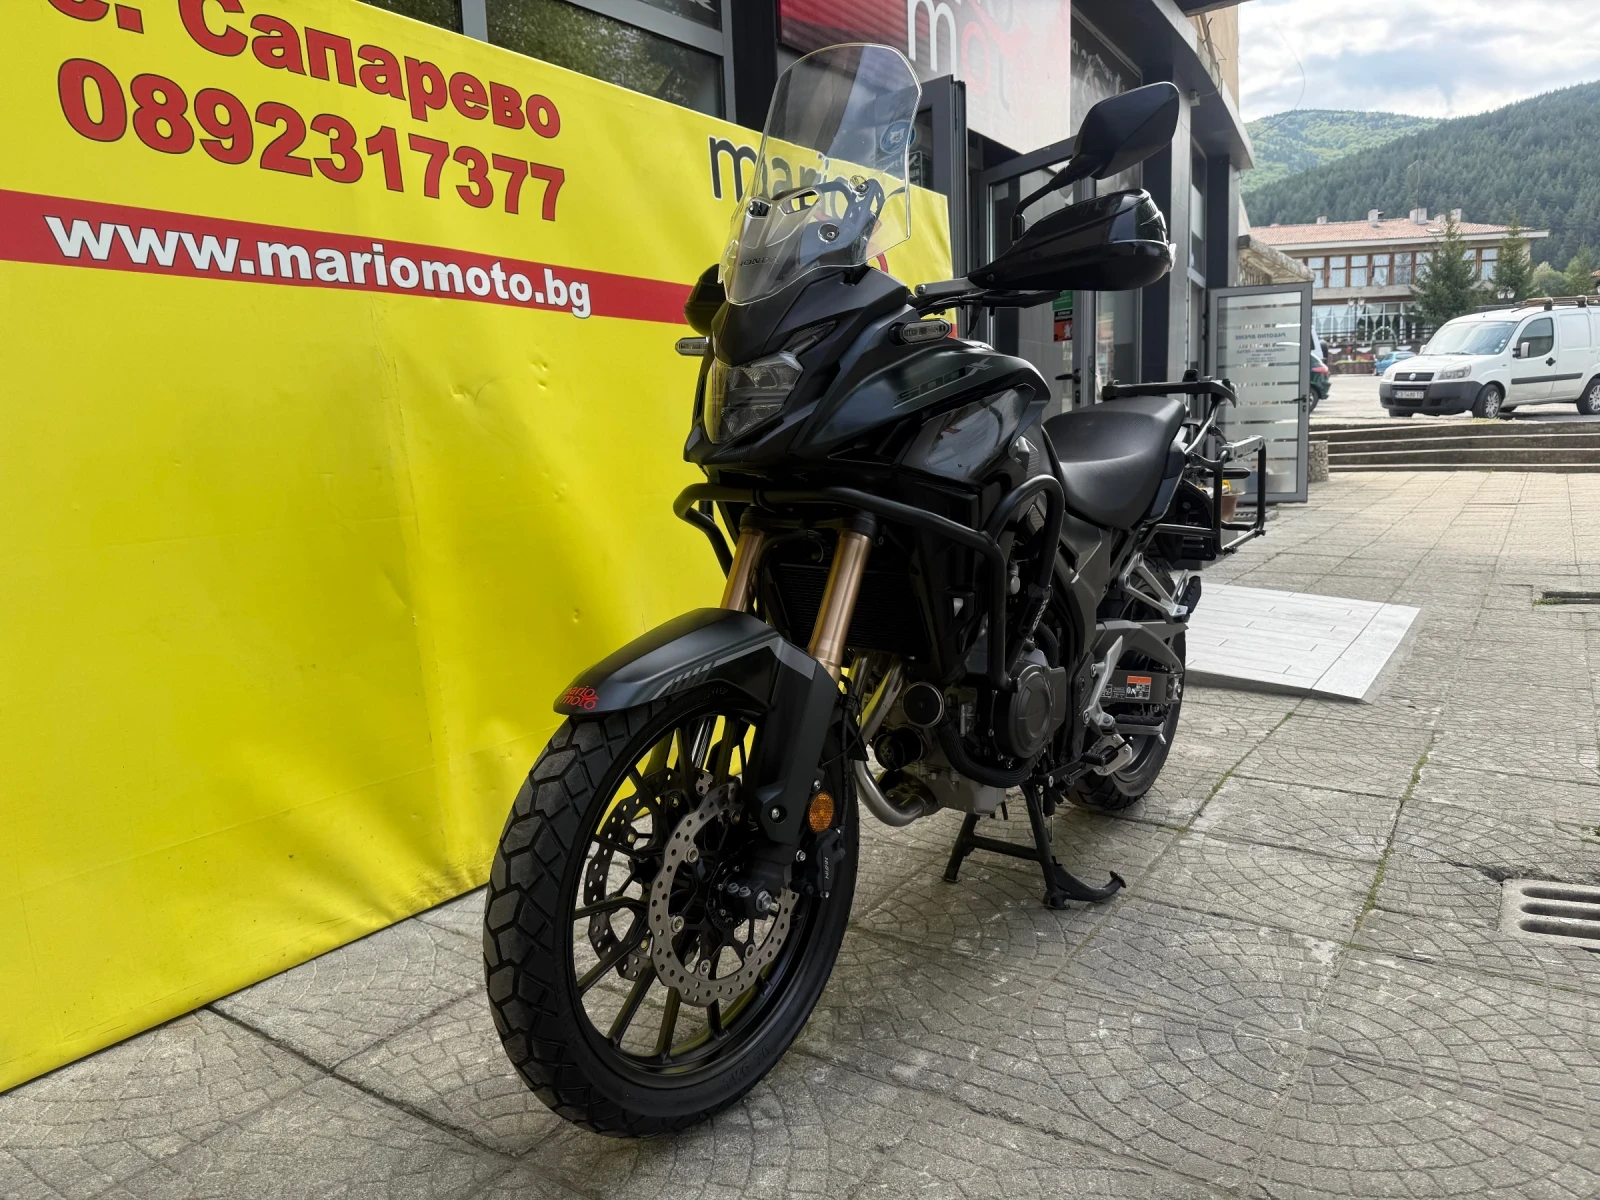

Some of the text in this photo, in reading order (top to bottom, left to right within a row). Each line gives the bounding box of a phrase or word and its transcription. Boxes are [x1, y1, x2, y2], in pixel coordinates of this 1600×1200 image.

[178, 0, 561, 139] Сапарево
[57, 58, 565, 222] 0892317377
[43, 215, 592, 319] www.mariomoto.bg
